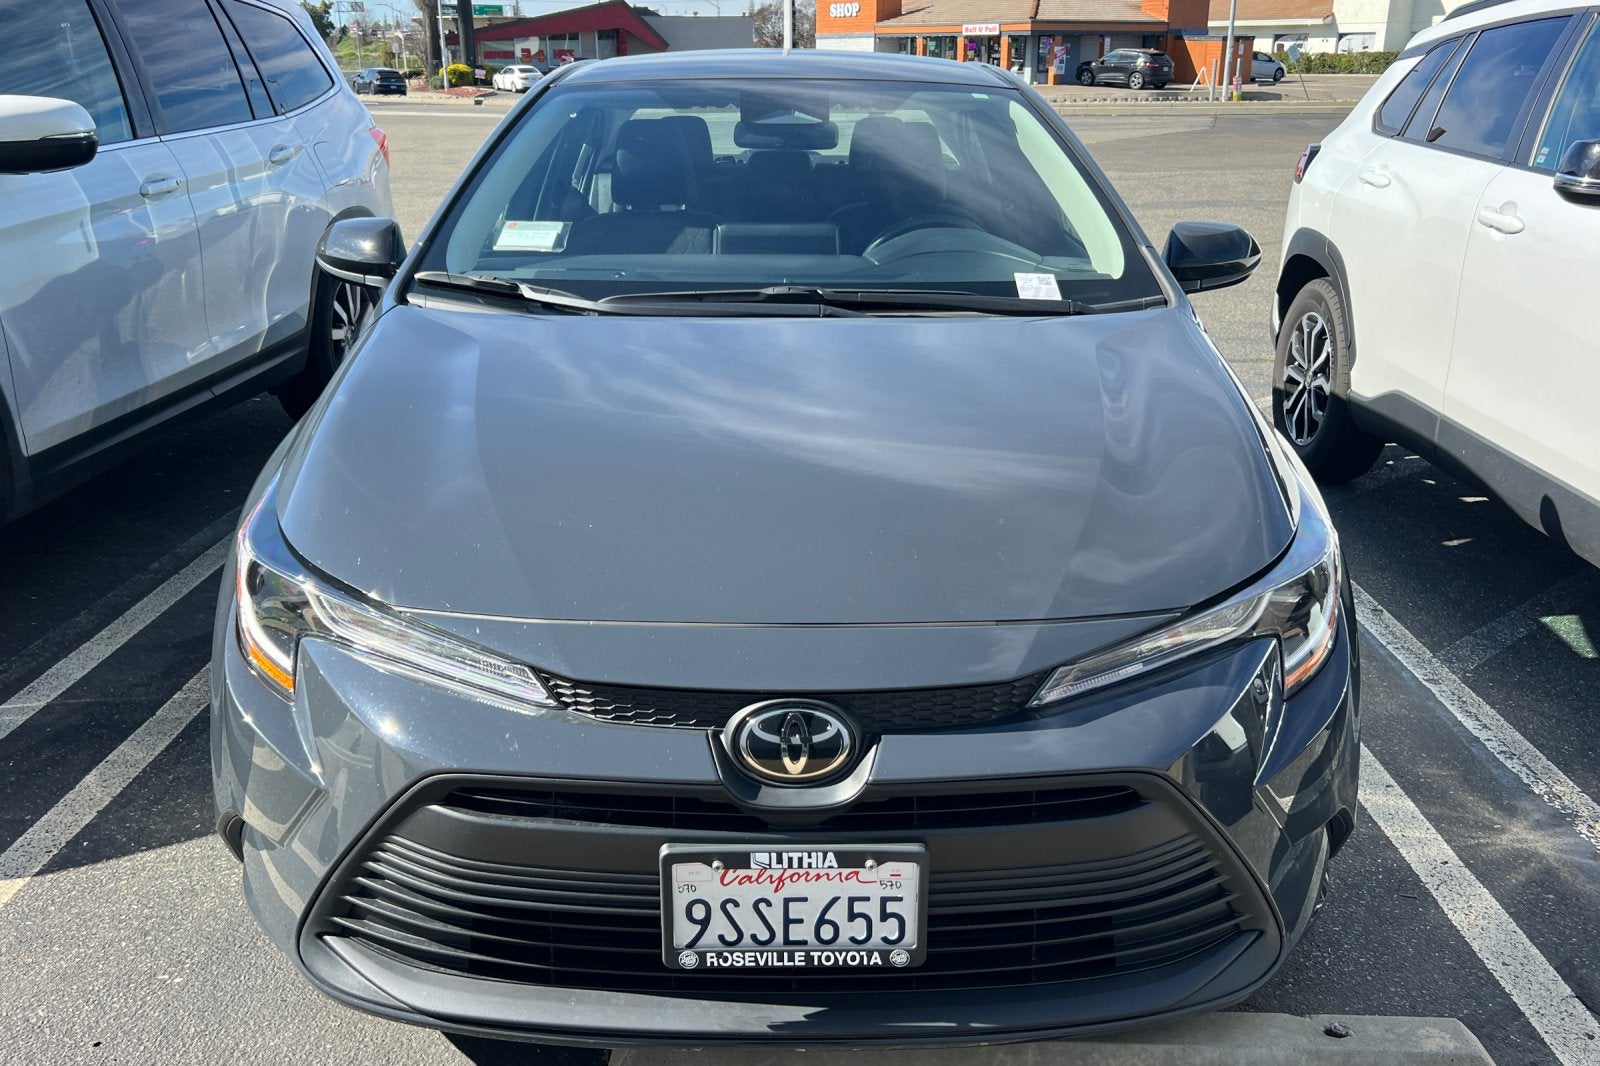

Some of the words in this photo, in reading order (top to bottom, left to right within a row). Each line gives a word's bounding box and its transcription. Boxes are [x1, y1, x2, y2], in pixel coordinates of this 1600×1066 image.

[829, 3, 860, 17] SHOP
[771, 851, 839, 869] LITHIA
[719, 867, 878, 894] California
[879, 880, 902, 890] 570
[684, 895, 907, 949] 9SSE655
[706, 951, 806, 967] ROSEVILLE
[809, 951, 883, 966] TOYOTA
